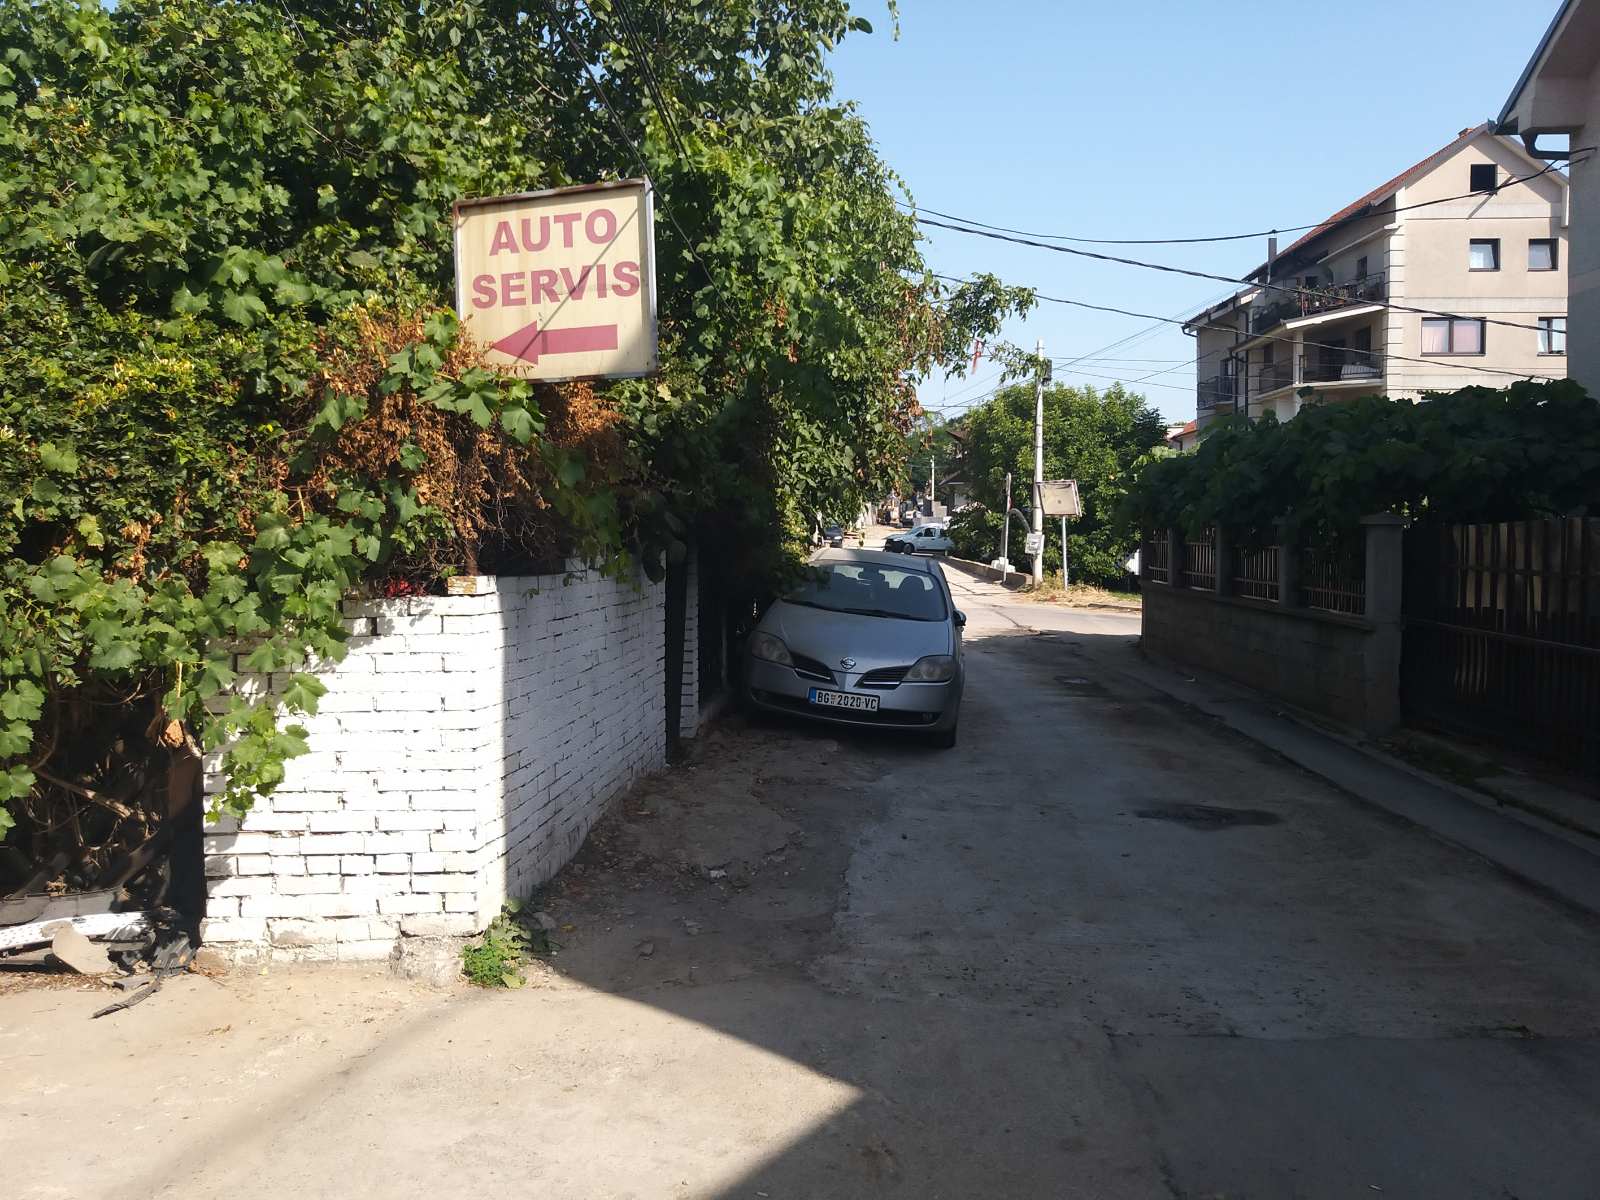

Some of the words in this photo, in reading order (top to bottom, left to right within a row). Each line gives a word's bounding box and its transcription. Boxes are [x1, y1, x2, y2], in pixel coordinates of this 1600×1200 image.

[489, 208, 617, 257] AUTO
[471, 260, 641, 310] SERVIS
[817, 691, 830, 704] BG
